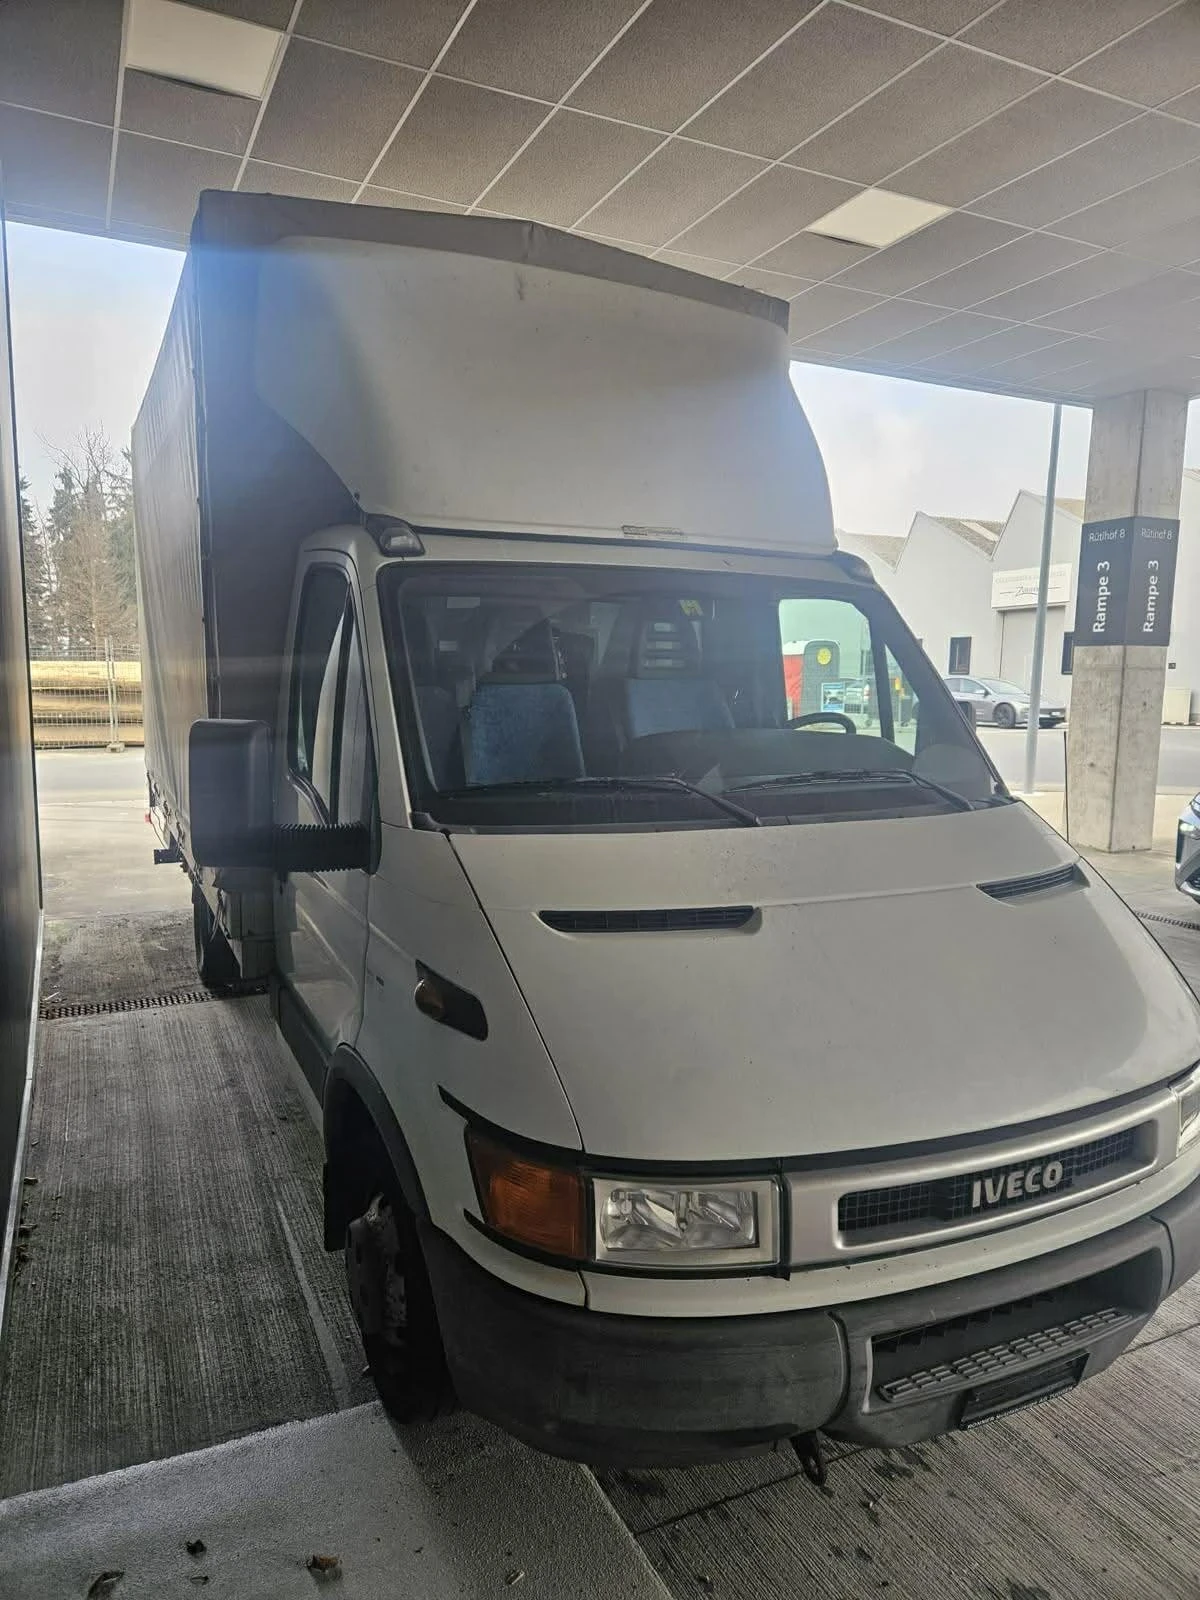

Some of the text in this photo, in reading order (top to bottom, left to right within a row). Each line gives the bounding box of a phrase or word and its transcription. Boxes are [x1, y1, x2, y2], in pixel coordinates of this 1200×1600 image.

[1119, 528, 1126, 539] 8
[1166, 530, 1173, 540] 8
[1092, 560, 1111, 632] Rampe 3
[1143, 560, 1159, 632] Rampe 3
[971, 1161, 1064, 1209] IVECO
